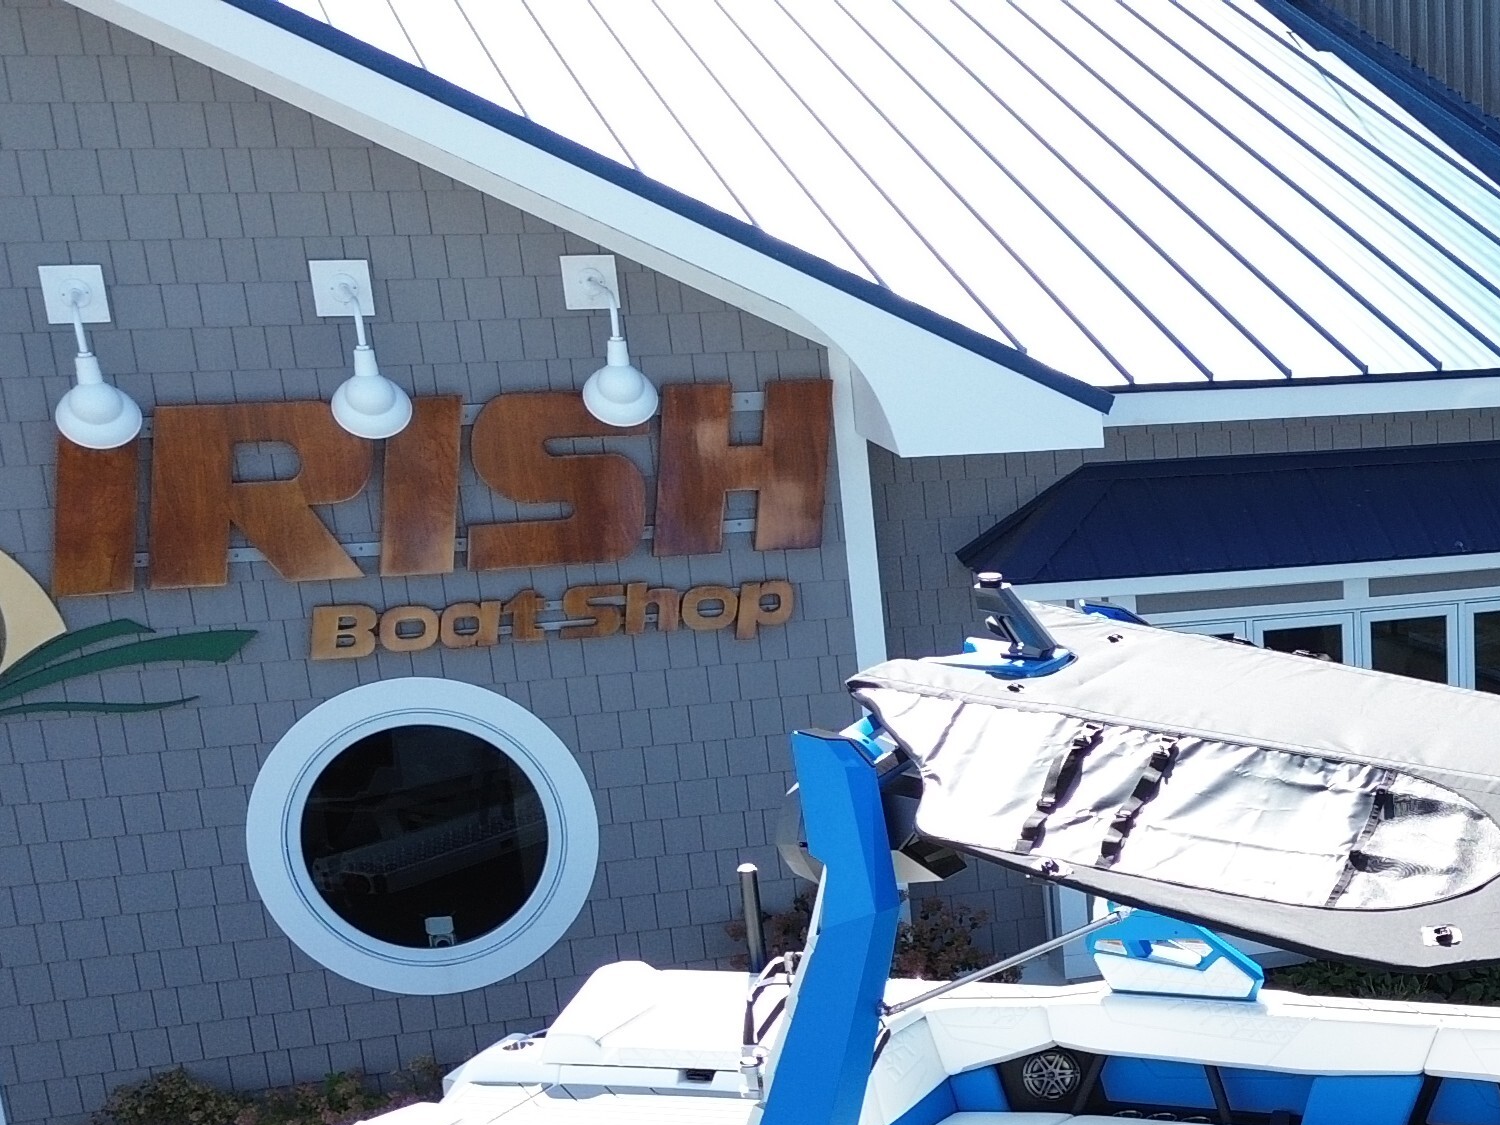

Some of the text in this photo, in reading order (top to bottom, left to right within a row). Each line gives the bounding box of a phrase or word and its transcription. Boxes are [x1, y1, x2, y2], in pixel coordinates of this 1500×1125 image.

[52, 379, 833, 597] IRISH
[311, 579, 796, 661] Boat Shop
